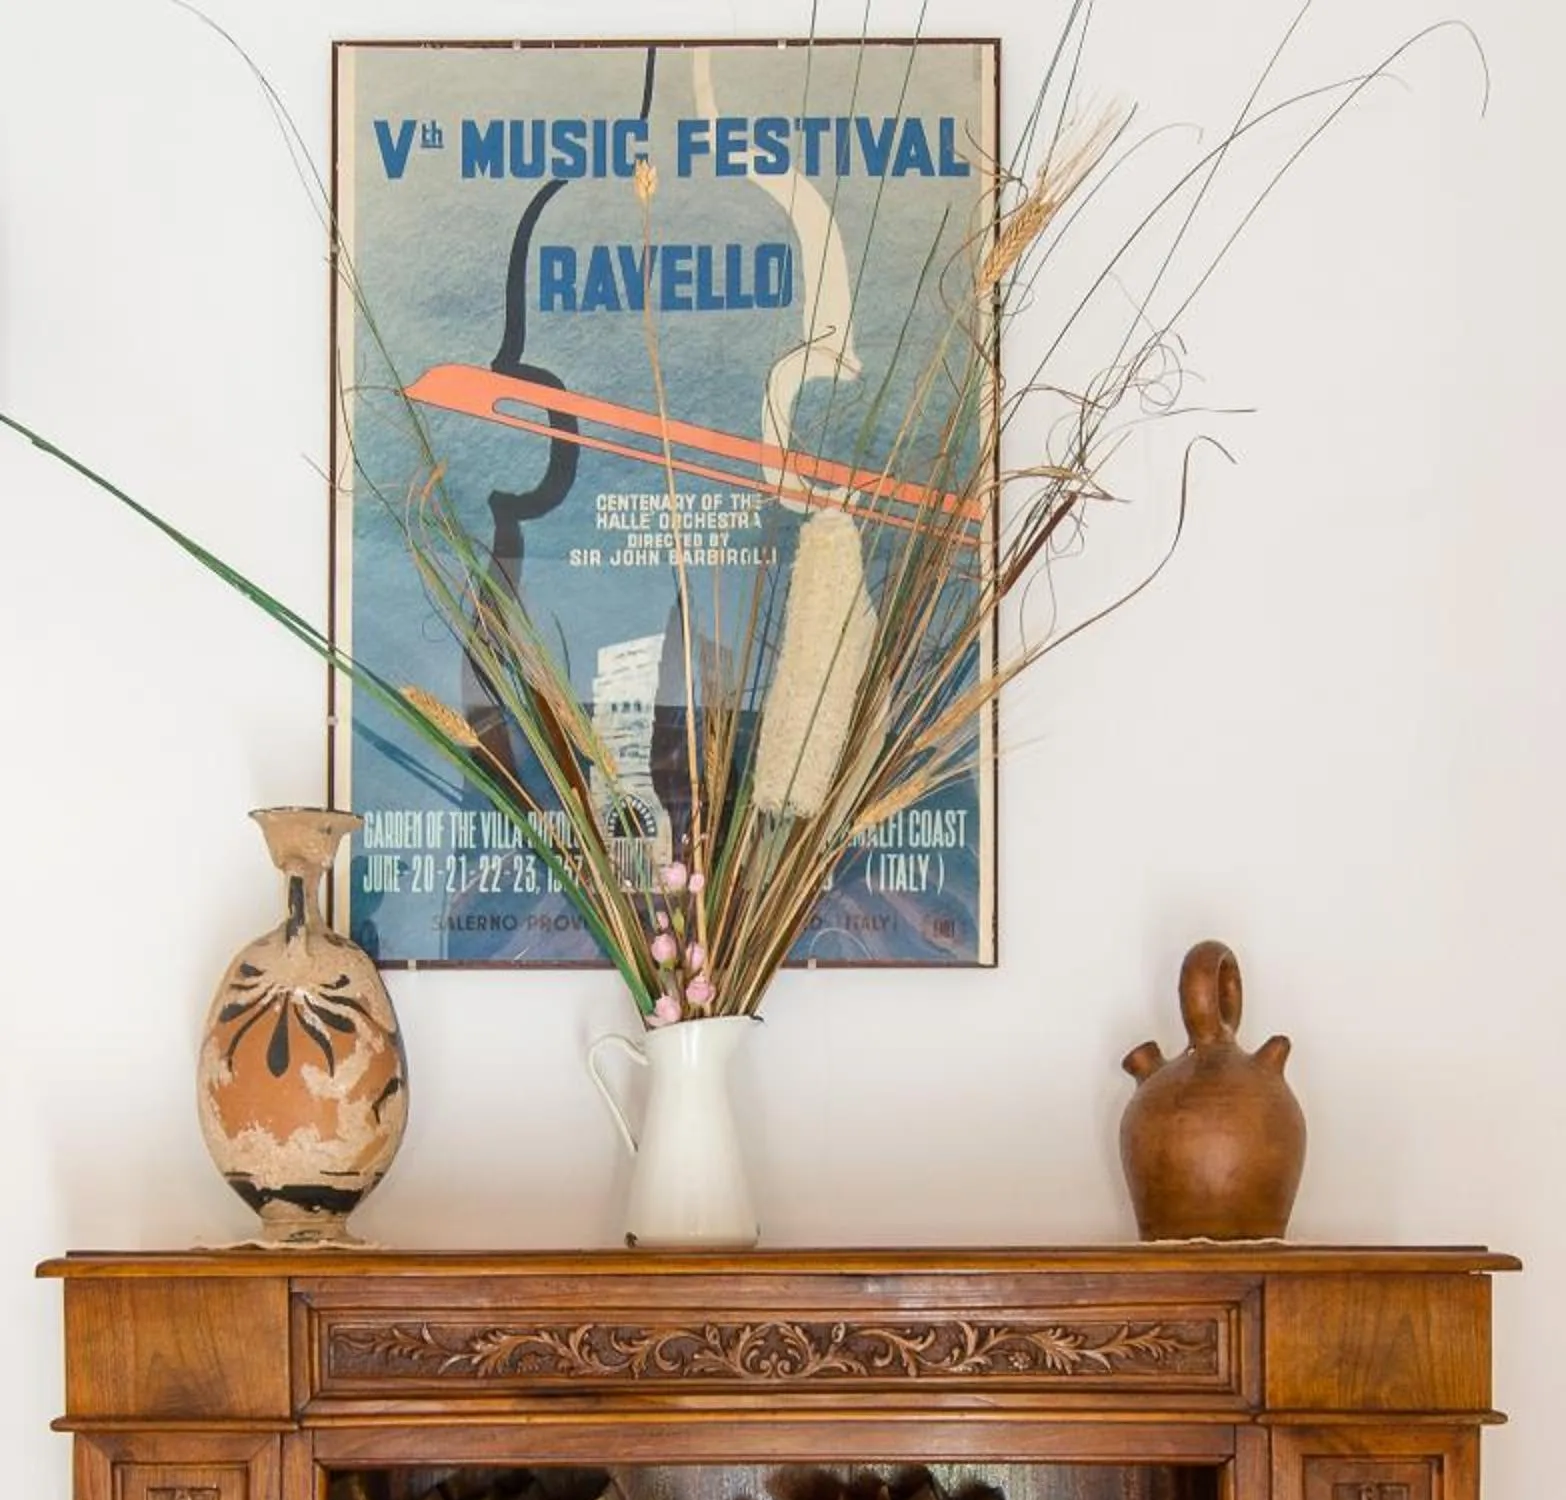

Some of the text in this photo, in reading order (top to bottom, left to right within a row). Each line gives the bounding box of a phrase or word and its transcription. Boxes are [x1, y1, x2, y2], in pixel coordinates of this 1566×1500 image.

[461, 118, 650, 180] MUSIC
[676, 116, 971, 178] FESTIVAL
[538, 242, 794, 312] RAVELLO
[597, 493, 762, 512] CENTENARY OF THE
[628, 532, 729, 548] DIRECED BY
[569, 549, 601, 567] SIR
[610, 549, 660, 566] JOHN
[363, 811, 423, 850] GARDEN
[426, 811, 445, 849] OF
[449, 811, 477, 849] THE
[908, 810, 968, 847] COAST
[431, 914, 518, 932] SALERNO
